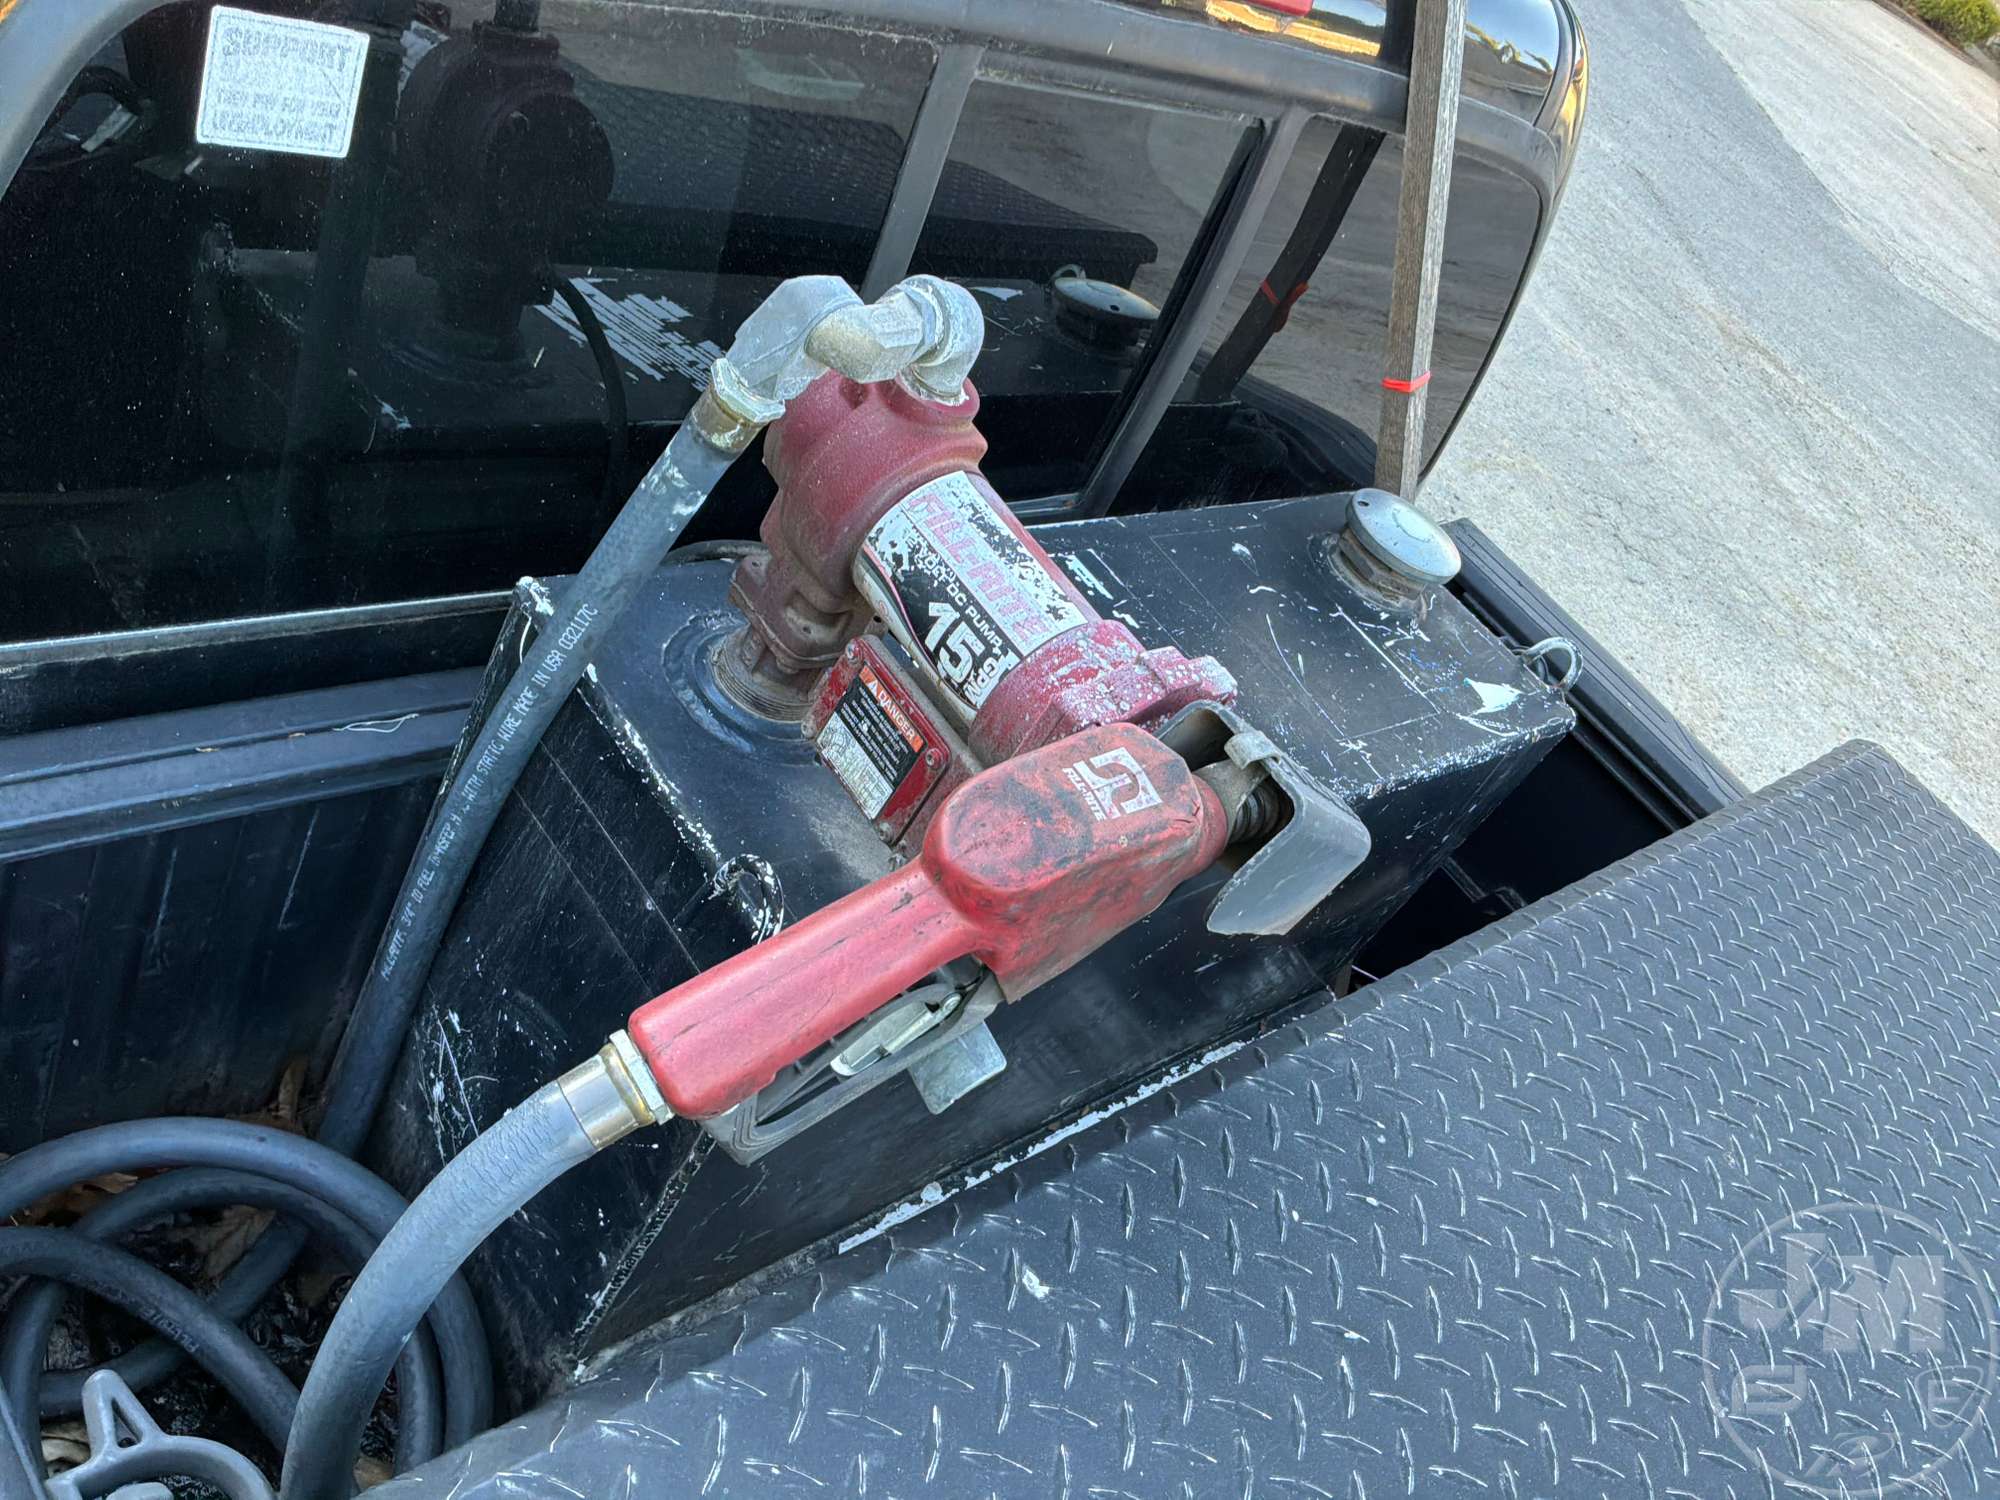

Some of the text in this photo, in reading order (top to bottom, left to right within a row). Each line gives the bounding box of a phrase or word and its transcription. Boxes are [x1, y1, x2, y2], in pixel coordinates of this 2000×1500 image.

[928, 602, 987, 679] 15
[944, 582, 968, 607] DC
[964, 605, 1003, 648] PUMP
[460, 774, 484, 801] WITH
[476, 738, 505, 776] STATIC
[496, 711, 522, 742] WIRE
[512, 685, 540, 716] MADE
[530, 668, 551, 688] IN
[541, 647, 567, 674] USA
[558, 605, 600, 650] 032117C
[877, 690, 916, 740] DANGER
